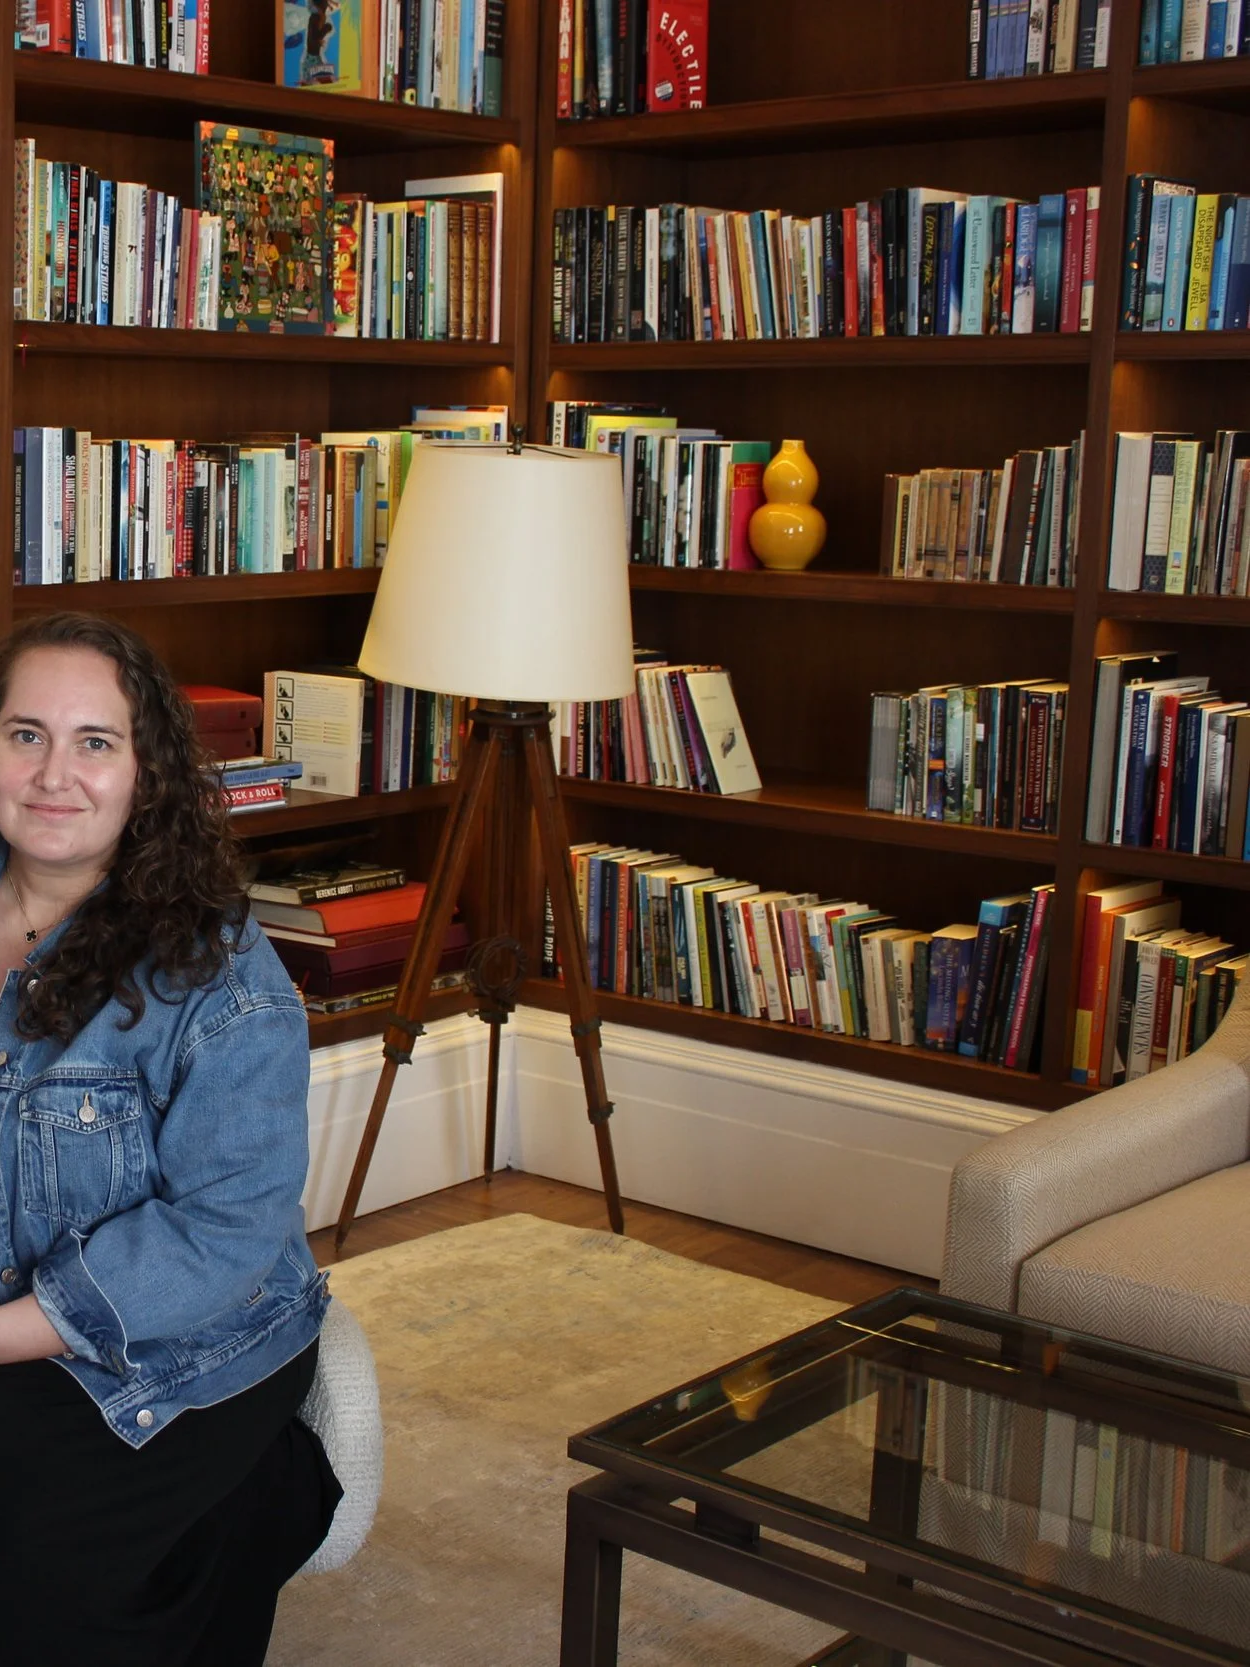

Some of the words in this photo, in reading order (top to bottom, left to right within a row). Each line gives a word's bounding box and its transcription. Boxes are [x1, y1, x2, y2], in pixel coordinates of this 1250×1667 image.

[76, 1, 86, 41] STRIKES
[70, 170, 79, 198] FINAL
[70, 202, 79, 231] GIRLS
[1157, 200, 1168, 234] TRAVELS
[1207, 206, 1215, 222] THE
[925, 216, 937, 255] CENTRAL
[970, 218, 983, 265] Unanswered
[1085, 219, 1094, 240] RICK
[1193, 209, 1206, 270] DISAPPEARED
[1204, 224, 1213, 253] NIGHT
[69, 238, 78, 266] RILEY
[1084, 243, 1093, 275] MOODY
[1154, 245, 1165, 277] BARLEY
[1201, 255, 1211, 273] SHE
[924, 258, 936, 285] PARK
[969, 266, 981, 289] Letter
[68, 271, 77, 304] SAGER
[1190, 277, 1200, 312] JEWELL
[1199, 284, 1208, 304] LISA
[65, 455, 76, 477] SHAQ
[81, 462, 89, 495] SMOKE
[65, 478, 76, 504] UNCUT
[166, 493, 174, 525] MOODY
[1139, 718, 1147, 731] THE
[1160, 715, 1173, 768] STRONGER
[315, 886, 337, 899] BERENICE
[337, 884, 354, 896] ABBOTT
[1133, 973, 1155, 1056] CONSEQUENCES
